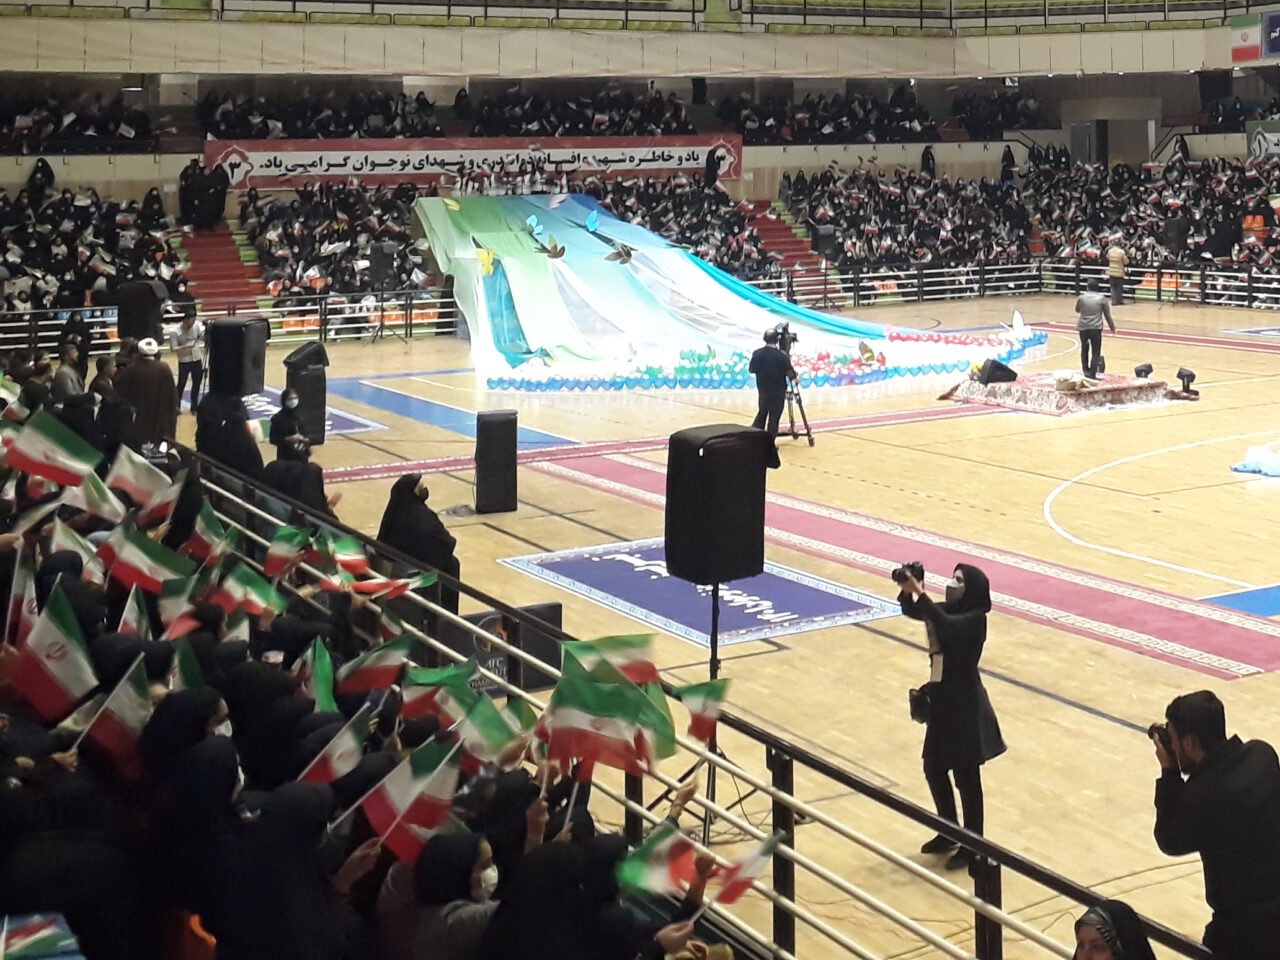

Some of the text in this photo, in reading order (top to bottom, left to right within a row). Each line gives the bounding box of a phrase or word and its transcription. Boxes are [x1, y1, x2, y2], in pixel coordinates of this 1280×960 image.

[285, 154, 351, 173] گرامی
[352, 153, 411, 172] نوجوان
[627, 149, 674, 167] خاطره
[684, 149, 700, 165] یاد
